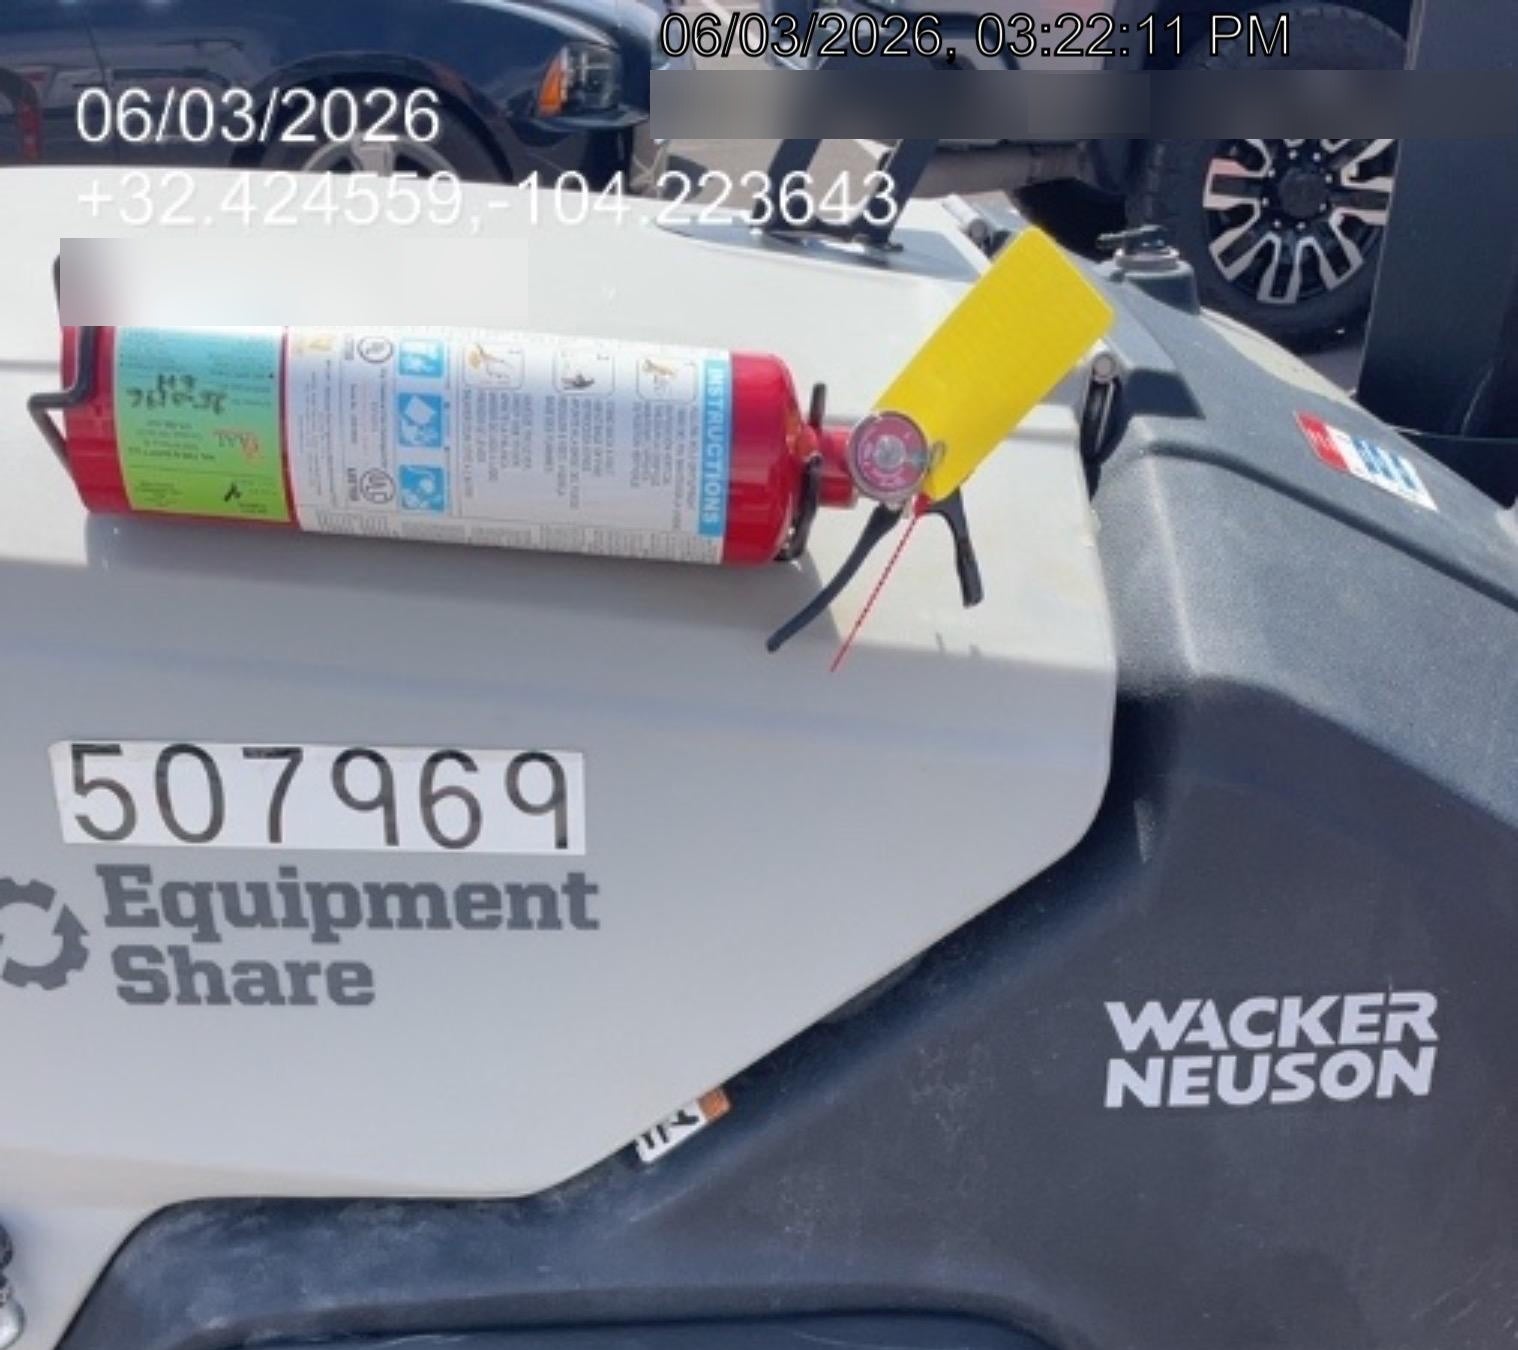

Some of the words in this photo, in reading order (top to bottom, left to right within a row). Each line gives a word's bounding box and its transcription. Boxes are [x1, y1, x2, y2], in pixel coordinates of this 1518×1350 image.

[702, 366, 725, 525] INSTRUCTIONS
[70, 743, 569, 850] 507969
[96, 864, 601, 944] Equipment
[110, 945, 376, 1006] Share
[1103, 991, 1440, 1052] WACKER
[1103, 1046, 1437, 1108] NEUSON
